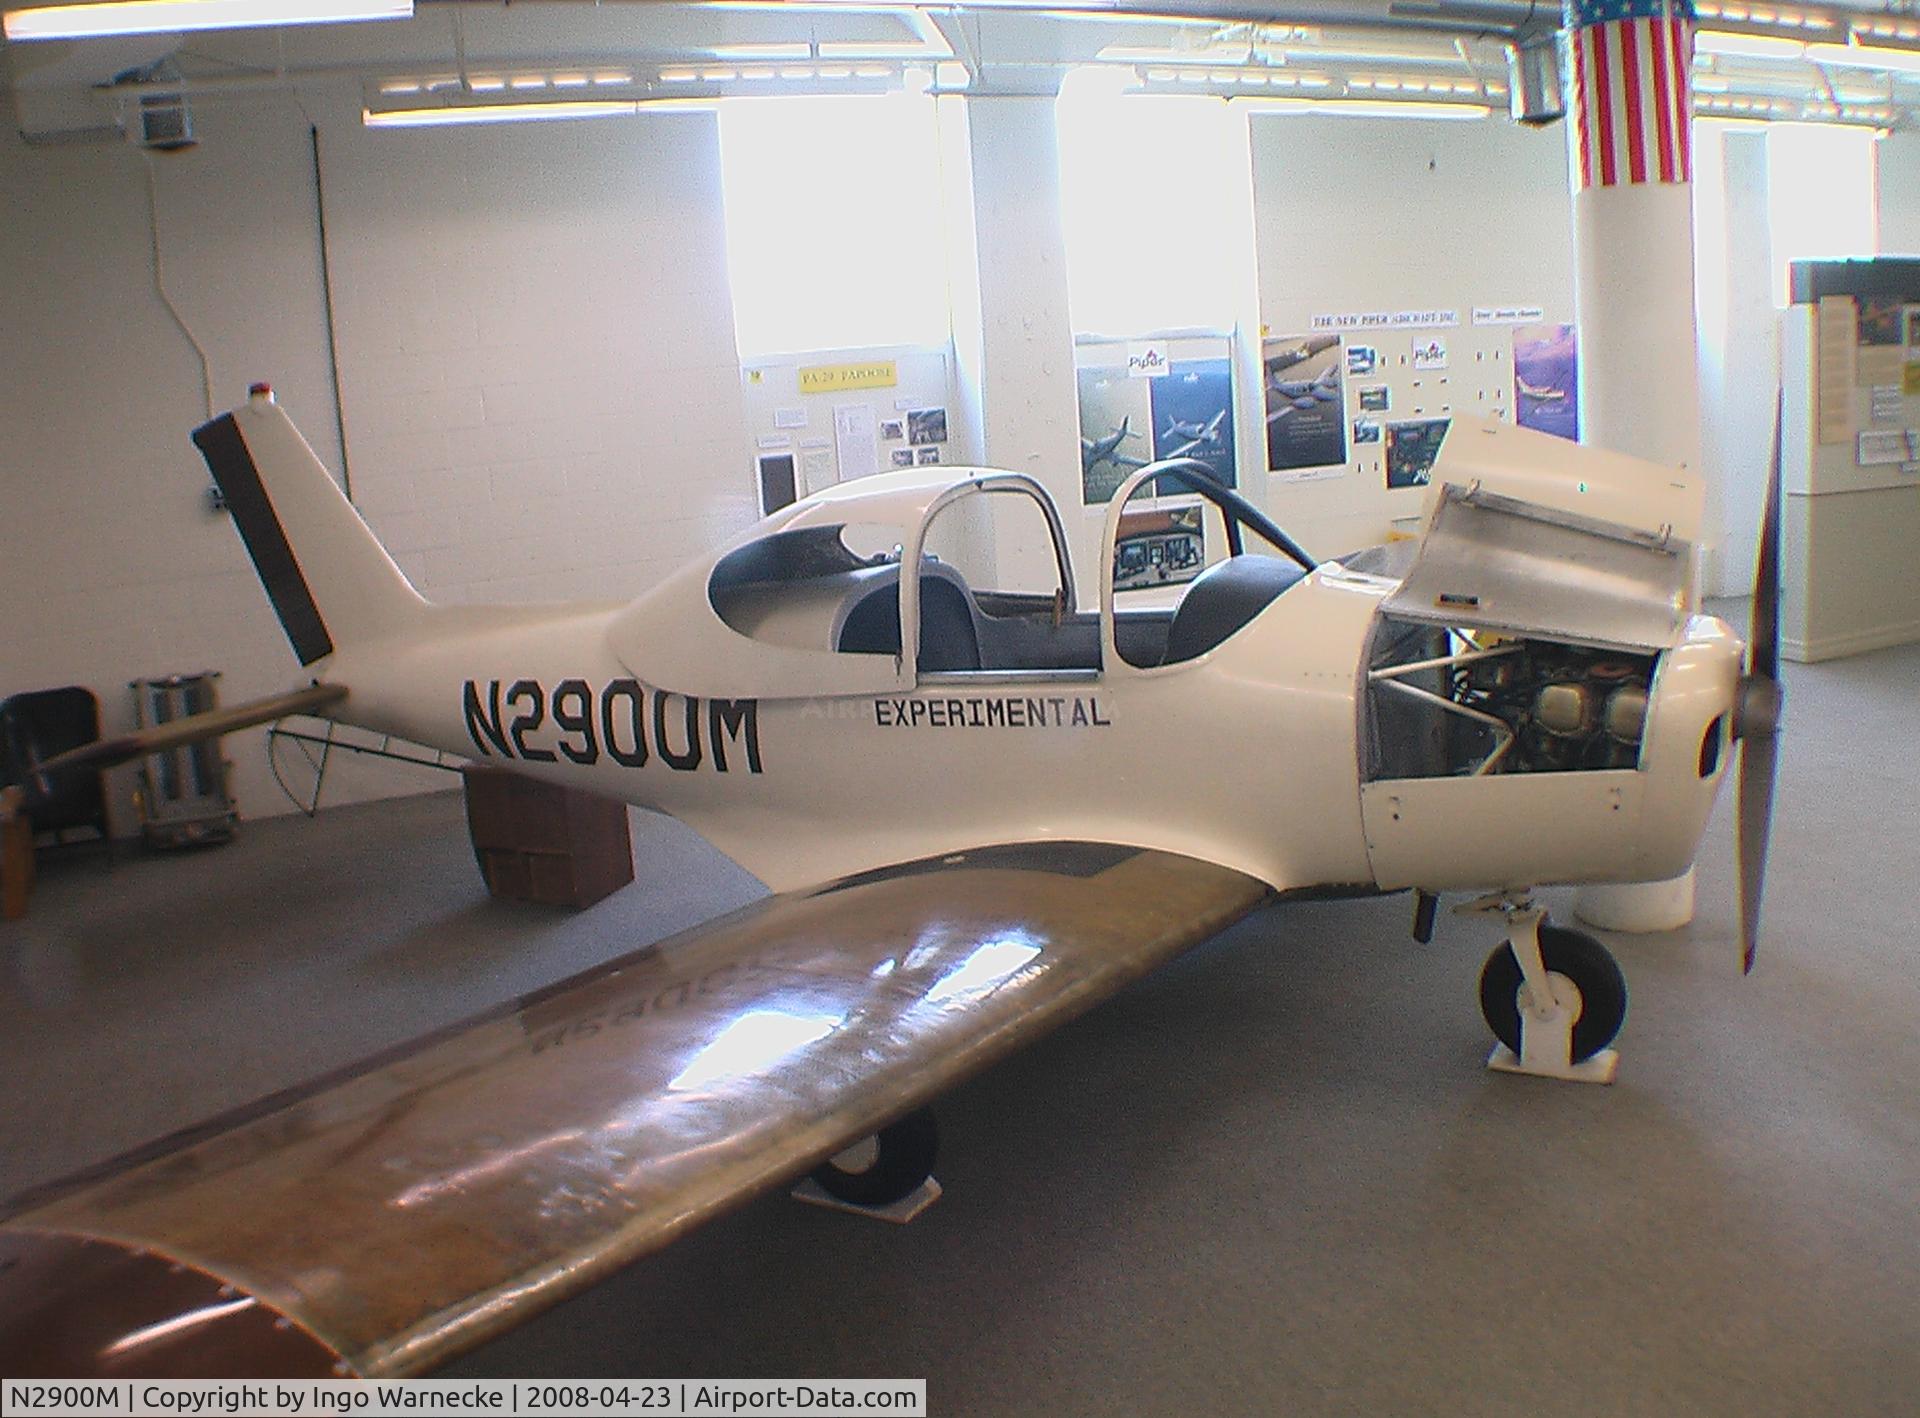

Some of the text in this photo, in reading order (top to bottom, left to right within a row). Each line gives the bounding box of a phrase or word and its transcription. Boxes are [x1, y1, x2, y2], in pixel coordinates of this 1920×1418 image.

[1128, 353, 1166, 370] Piper
[462, 678, 763, 774] N2900M
[874, 697, 1111, 727] EXPERIMENTAL
